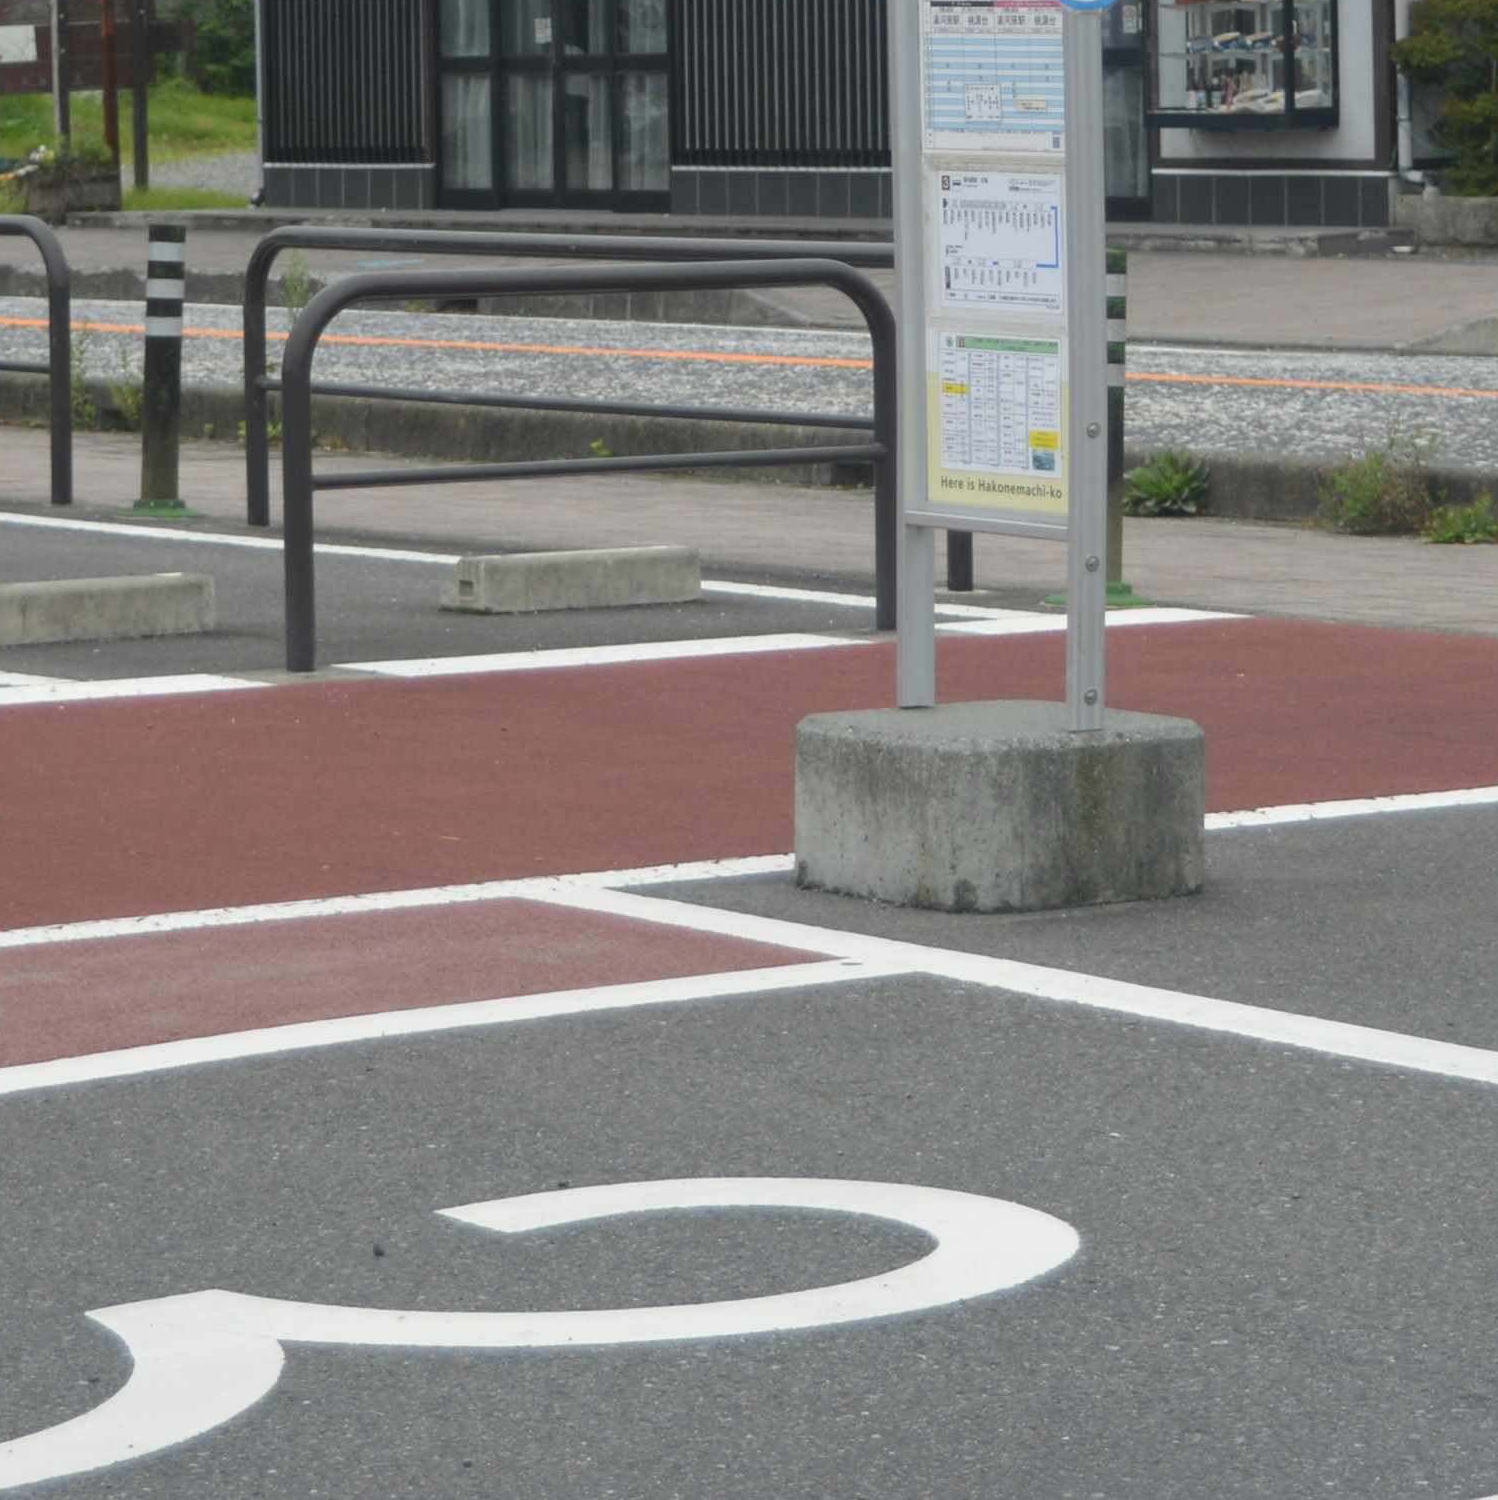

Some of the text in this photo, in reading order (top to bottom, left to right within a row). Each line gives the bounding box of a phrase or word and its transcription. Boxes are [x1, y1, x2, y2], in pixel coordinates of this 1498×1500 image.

[943, 176, 950, 190] 3
[941, 476, 1062, 499] Here is Hakonemachi-ko
